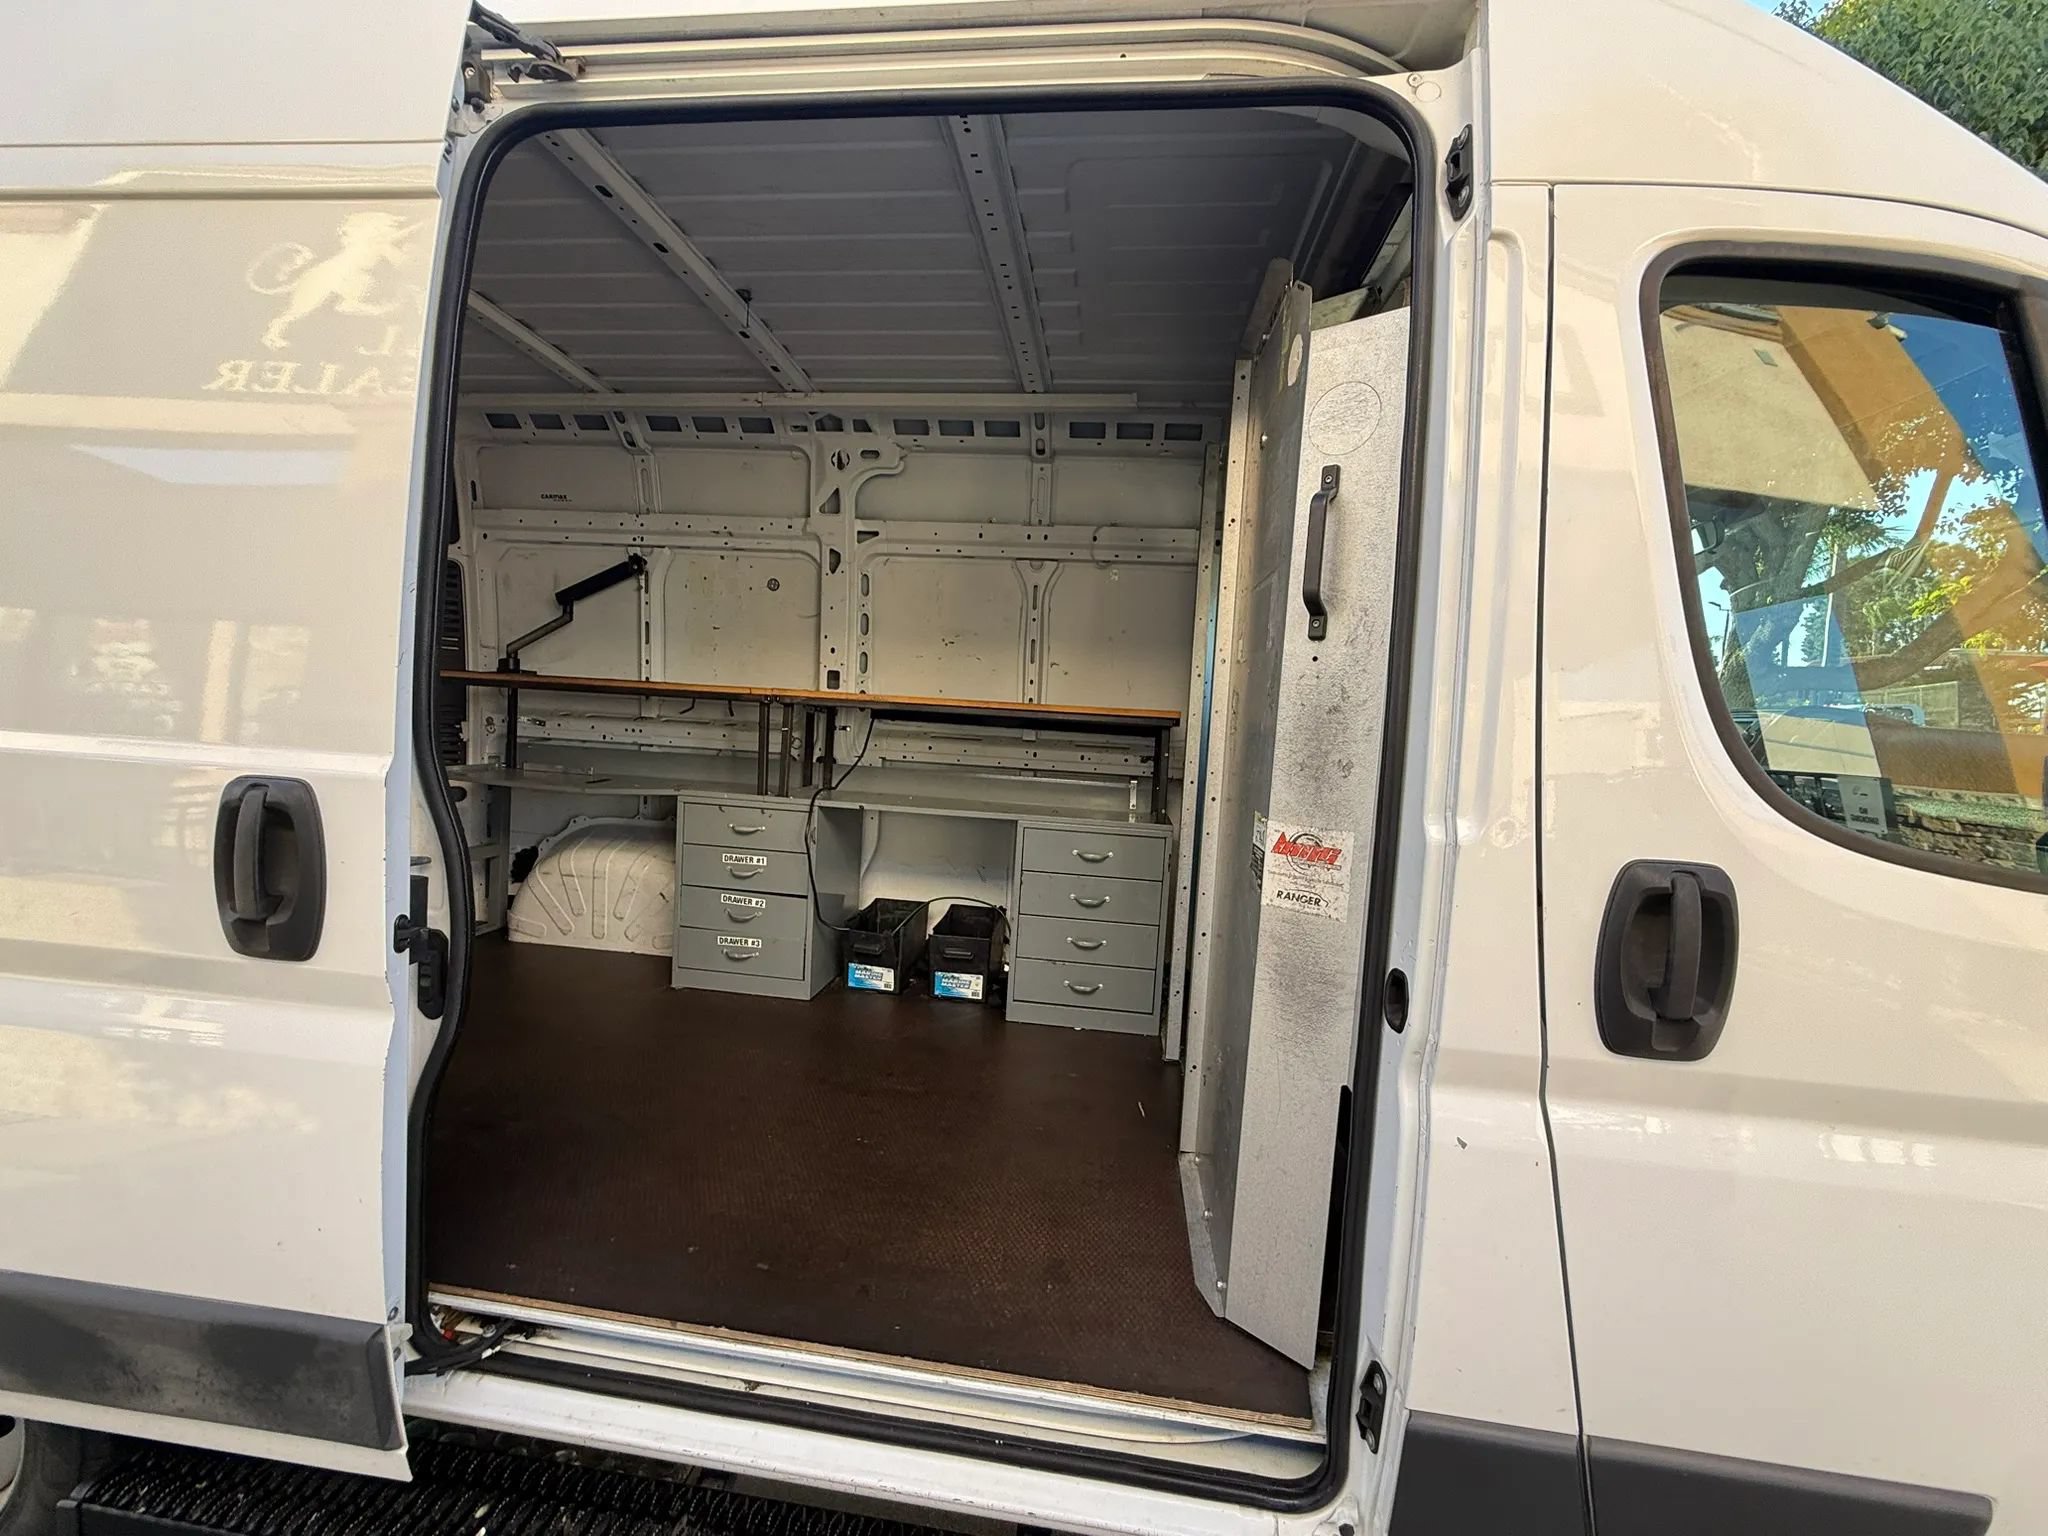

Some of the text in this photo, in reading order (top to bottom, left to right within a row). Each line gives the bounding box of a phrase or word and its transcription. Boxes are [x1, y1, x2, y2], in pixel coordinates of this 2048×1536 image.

[724, 854, 765, 865] DRAWER #1
[722, 895, 753, 906] DRAWER
[1276, 890, 1321, 907] RANGER
[719, 937, 749, 946] DRAWER
